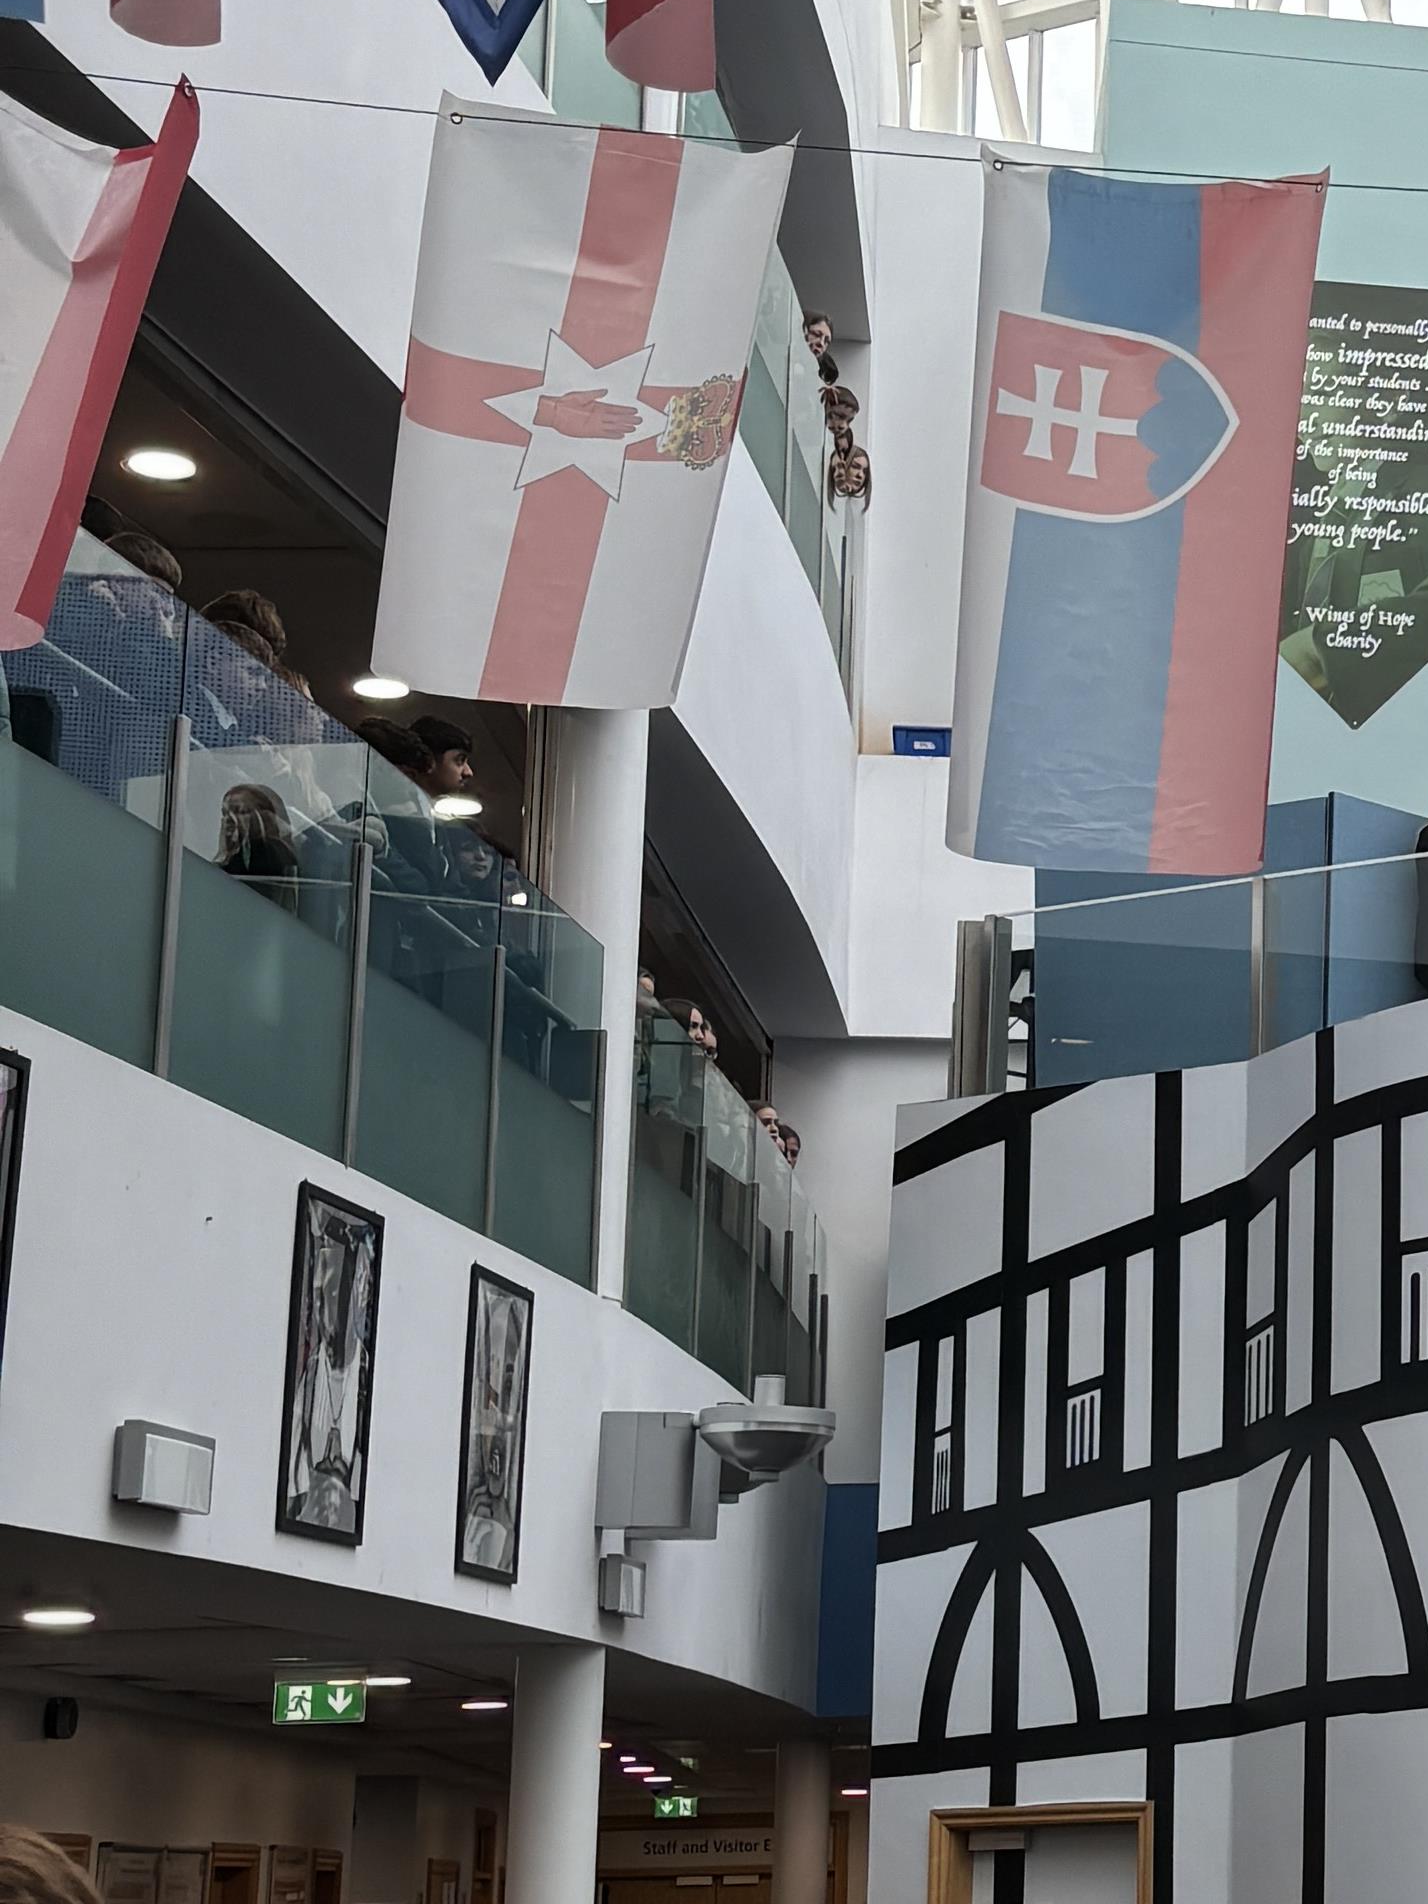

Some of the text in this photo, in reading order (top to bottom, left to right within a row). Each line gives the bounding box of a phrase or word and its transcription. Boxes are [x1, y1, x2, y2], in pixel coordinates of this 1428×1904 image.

[1309, 313, 1348, 330] anted
[1350, 319, 1362, 331] to
[1306, 344, 1333, 362] how
[1310, 367, 1328, 390] by
[1324, 374, 1366, 391] your
[1368, 373, 1421, 391] students
[1328, 391, 1362, 409] clear
[1365, 392, 1394, 417] they
[1397, 395, 1428, 413] have
[1298, 412, 1319, 434] al
[1296, 439, 1409, 465] of the importance
[1328, 463, 1378, 489] of being
[1292, 485, 1338, 517] ially
[1287, 523, 1345, 548] young
[1306, 605, 1356, 629] Wings
[1359, 604, 1377, 631] of
[1378, 611, 1416, 635] Hope
[643, 1838, 772, 1856] Staff and Visitor E
